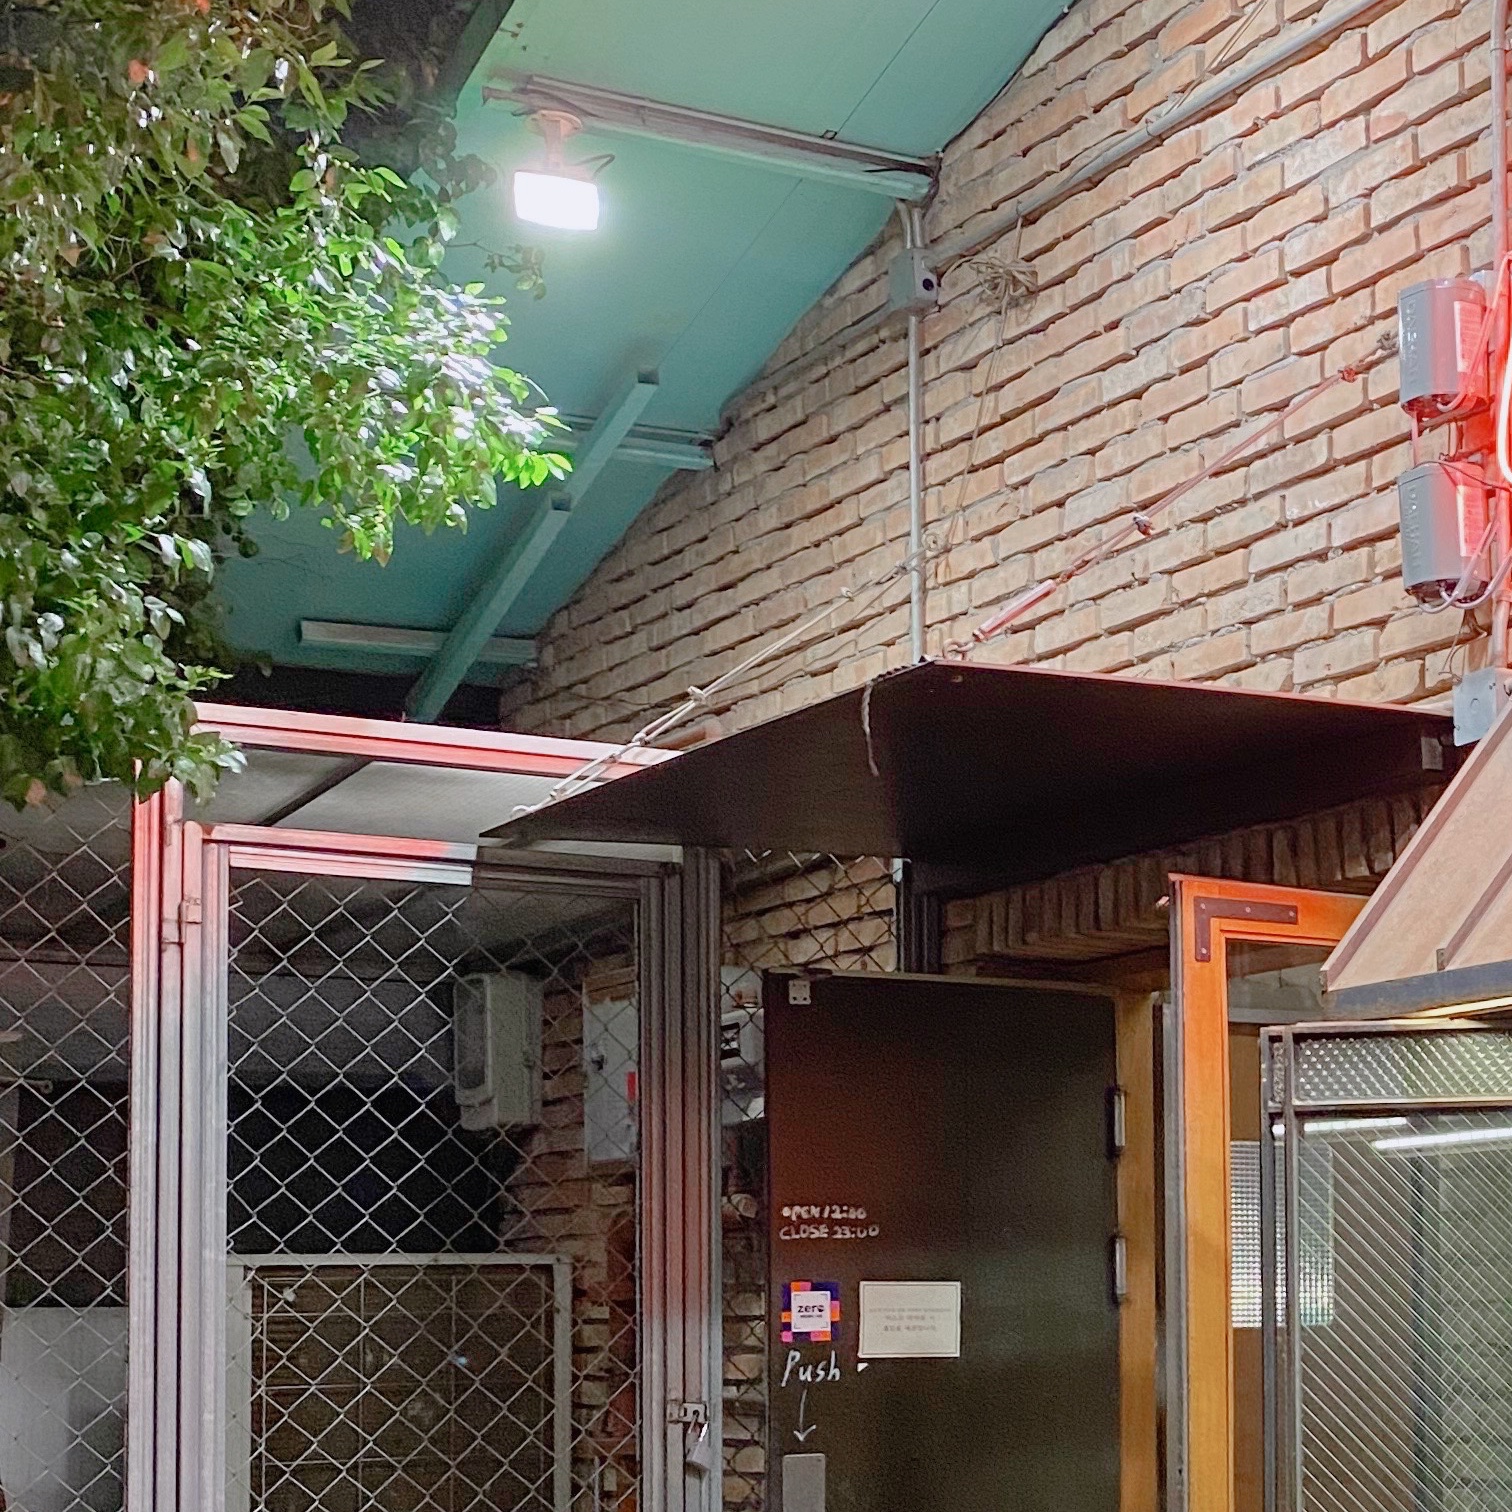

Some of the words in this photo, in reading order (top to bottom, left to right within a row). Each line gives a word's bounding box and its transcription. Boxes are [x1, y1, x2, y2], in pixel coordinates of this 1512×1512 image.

[781, 1205, 820, 1221] OPEN
[779, 1224, 828, 1239] CLOSE
[831, 1224, 880, 1239] 23:00
[797, 1304, 825, 1313] zero
[780, 1349, 841, 1387] Push
